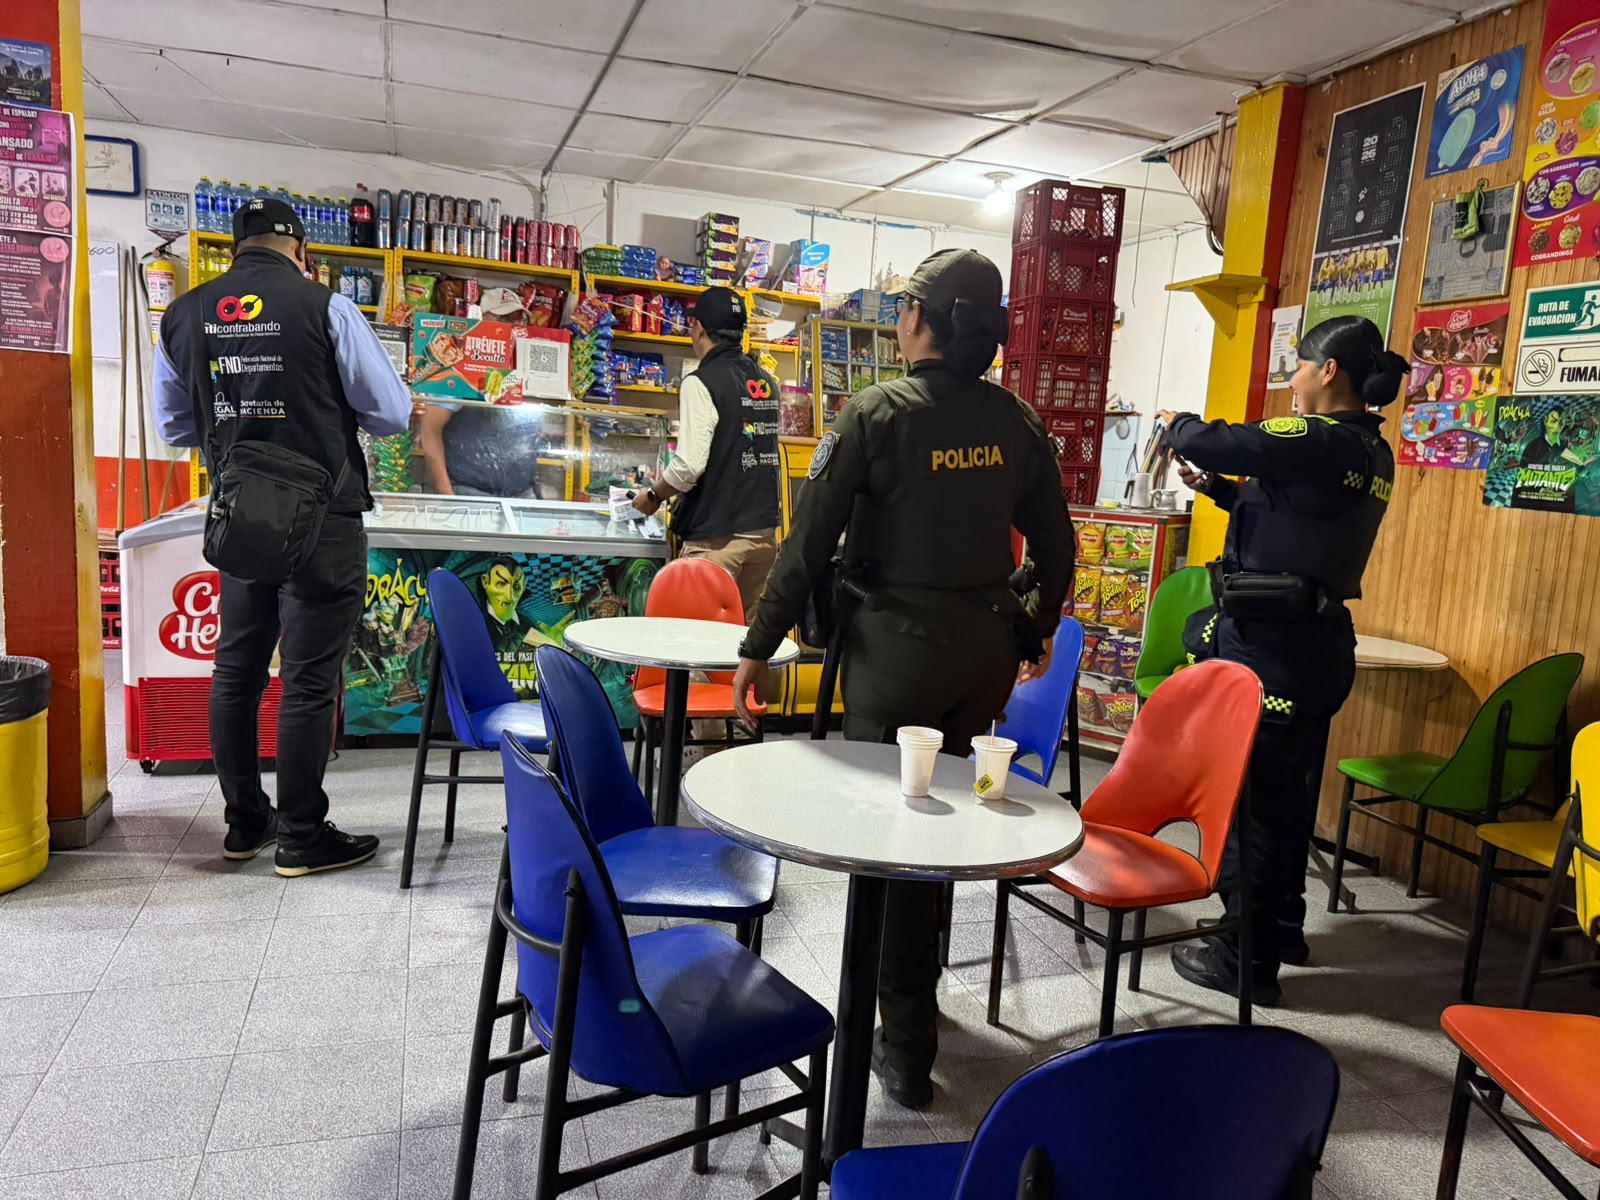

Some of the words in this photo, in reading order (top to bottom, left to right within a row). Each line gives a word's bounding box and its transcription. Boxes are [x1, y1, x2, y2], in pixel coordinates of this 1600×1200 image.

[1363, 135, 1379, 148] 20
[1530, 248, 1574, 261] COBRANDINGS
[1538, 303, 1558, 313] RUTA
[1558, 300, 1570, 311] DE
[1528, 313, 1577, 327] EVACUACION
[465, 335, 507, 356] ATRÉVETE
[218, 356, 241, 375] FND
[241, 362, 284, 376] Departamentos
[273, 399, 285, 407] de
[931, 444, 1004, 472] POLICIA
[1515, 467, 1577, 492] MUTANTE
[503, 652, 517, 662] DEL
